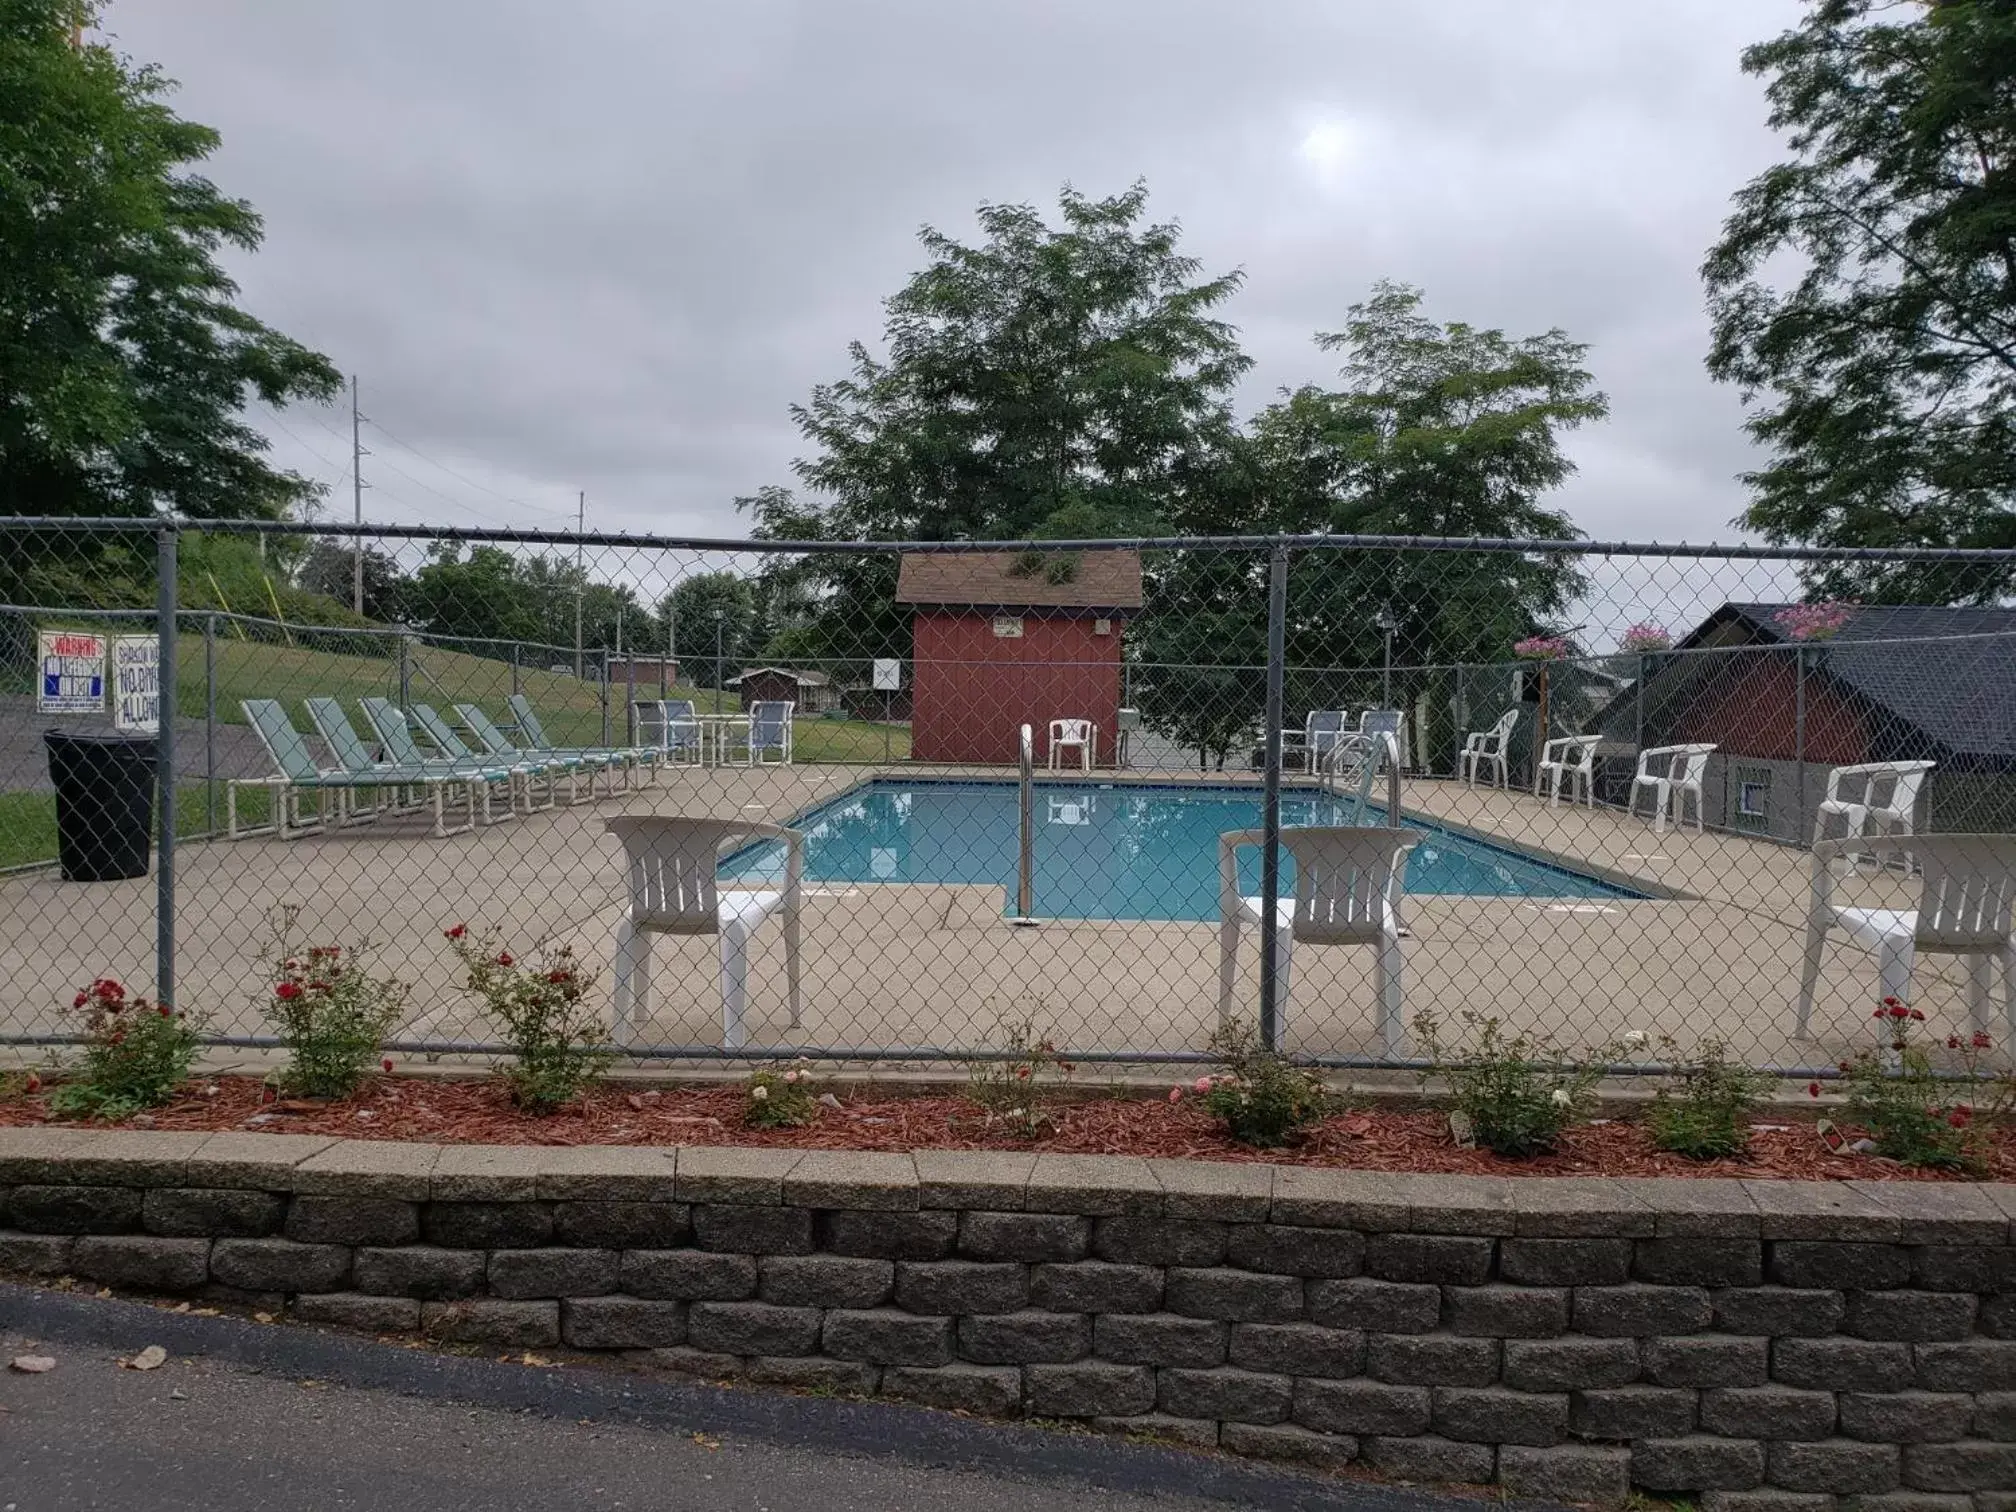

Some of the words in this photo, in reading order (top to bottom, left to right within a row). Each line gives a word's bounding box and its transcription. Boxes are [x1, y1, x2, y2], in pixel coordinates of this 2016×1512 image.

[55, 637, 96, 656] WARNING
[120, 667, 134, 693] NO
[123, 695, 159, 722] ALLOW
